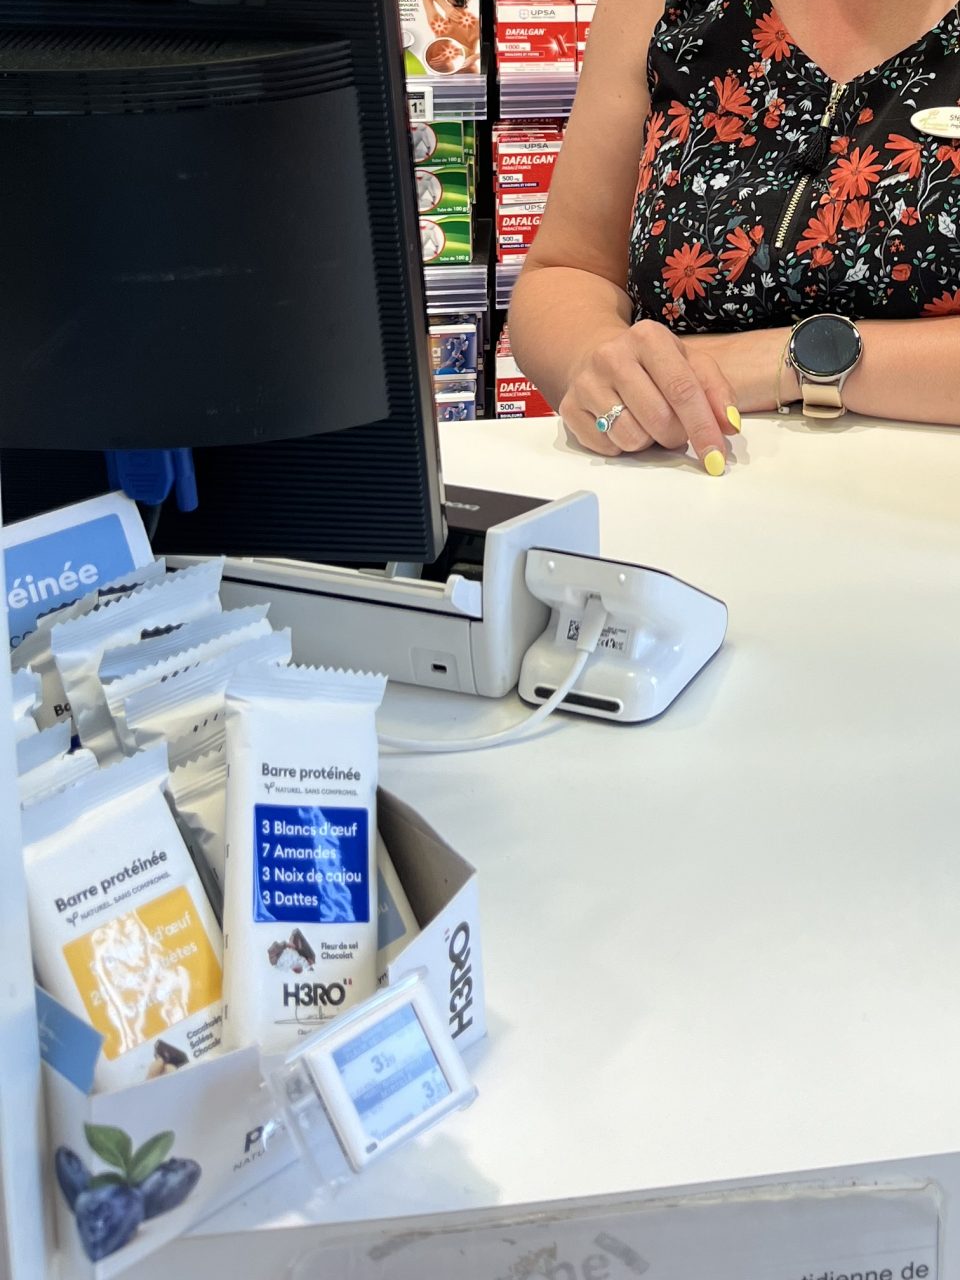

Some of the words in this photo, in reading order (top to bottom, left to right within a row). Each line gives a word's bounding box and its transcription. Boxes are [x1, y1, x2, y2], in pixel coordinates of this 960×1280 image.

[505, 28, 545, 36] DAFALGAN
[502, 154, 555, 165] DAFALGAN
[8, 560, 99, 610] éinée
[261, 763, 297, 778] Barre
[299, 761, 361, 782] protéinée
[275, 786, 302, 794] NATUREL.
[262, 821, 271, 834] 3
[274, 821, 316, 835] Blancs
[319, 822, 357, 837] d'œuf
[262, 843, 271, 857] 7
[274, 844, 337, 859] Amandes
[54, 883, 98, 914] Barre
[100, 849, 168, 894] protéinée
[262, 867, 271, 880] 3
[274, 868, 303, 883] Noix
[306, 869, 322, 883] de
[327, 870, 362, 889] cajou
[262, 891, 271, 904] 3
[275, 892, 318, 907] Dattes
[320, 951, 353, 960] Chocolat
[448, 920, 474, 1040] H3RO
[283, 982, 347, 1007] H3RO
[901, 1261, 929, 1280] de
